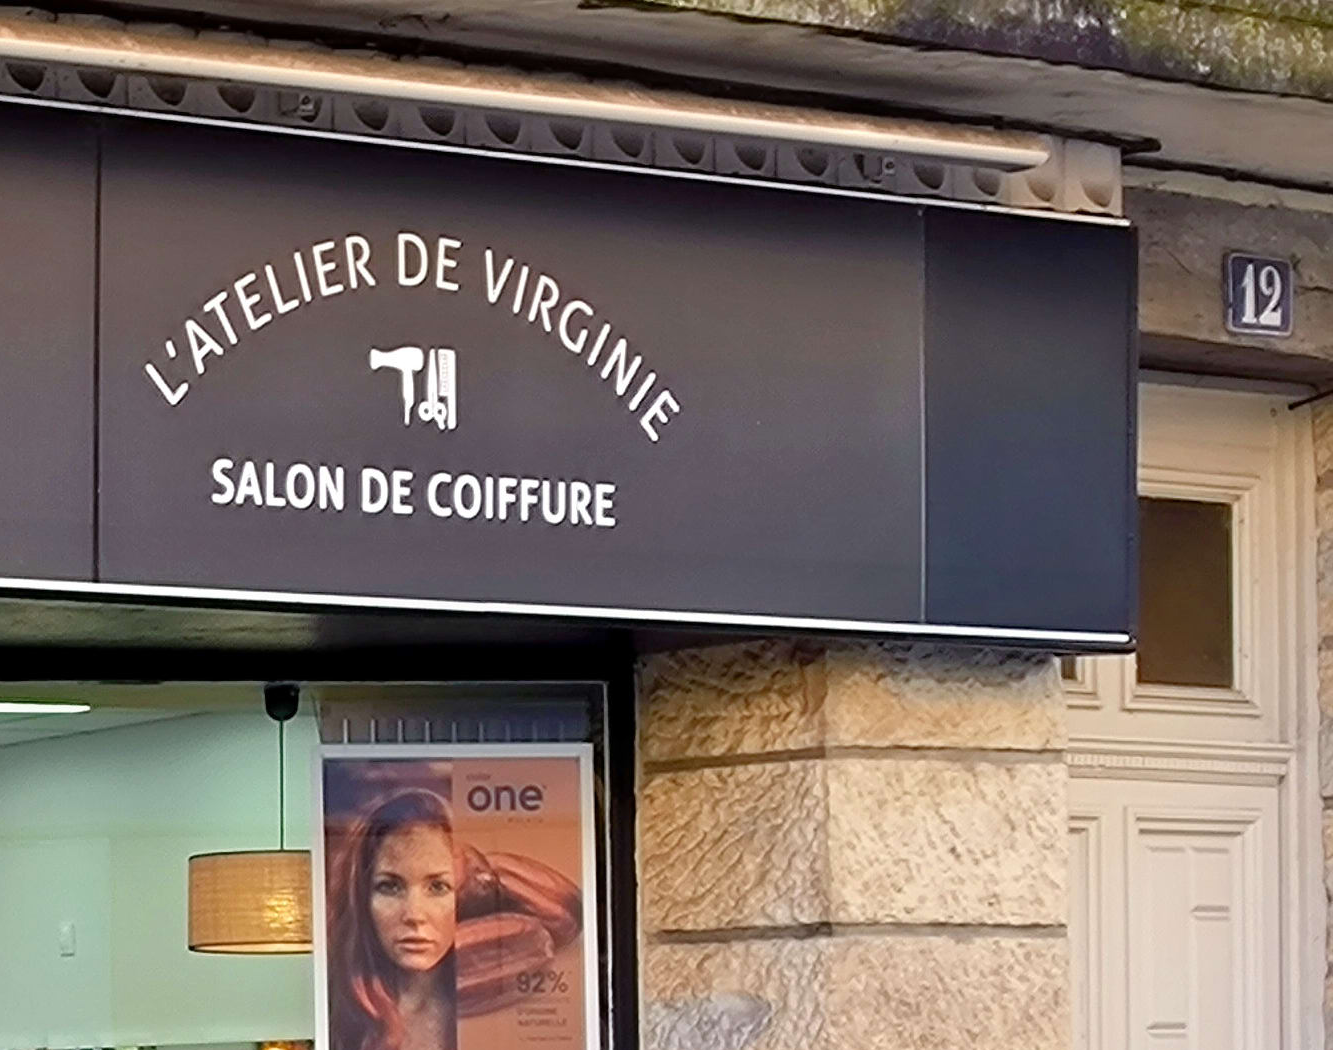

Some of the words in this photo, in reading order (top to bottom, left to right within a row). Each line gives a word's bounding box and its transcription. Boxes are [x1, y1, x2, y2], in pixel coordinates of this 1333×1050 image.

[1241, 263, 1282, 327] 12
[145, 233, 376, 406] L'ATELIER
[397, 233, 462, 291] DE
[485, 249, 680, 442] VIRGINIE
[211, 458, 344, 511] SALON
[361, 468, 413, 514] DE
[427, 472, 616, 527] COIFFURE
[467, 785, 543, 812] one
[516, 970, 569, 993] 92%
